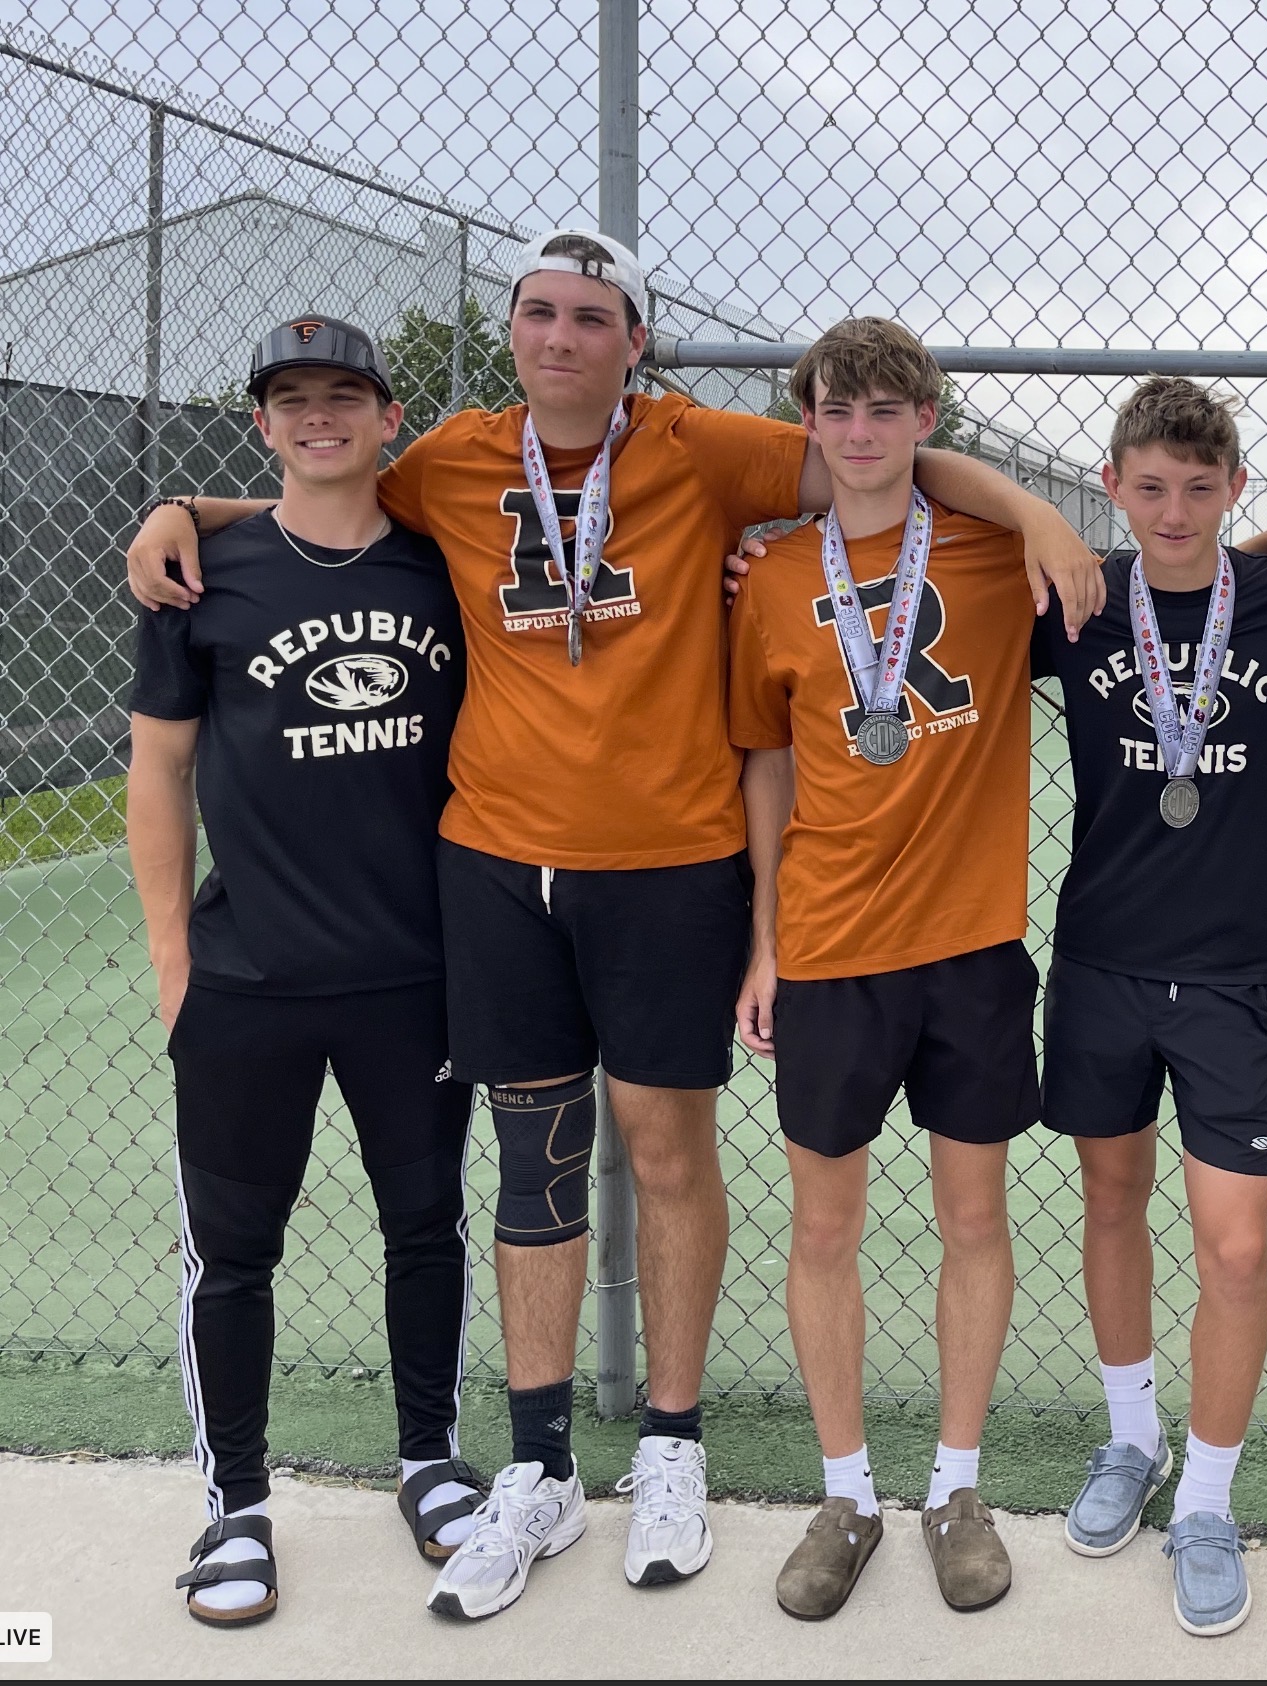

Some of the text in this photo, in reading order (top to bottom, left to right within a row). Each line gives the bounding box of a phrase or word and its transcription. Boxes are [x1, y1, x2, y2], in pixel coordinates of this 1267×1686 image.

[499, 488, 636, 617] R
[582, 601, 642, 622] TENNIS
[247, 610, 451, 689] REPUBLIC
[811, 574, 974, 741] R
[284, 714, 423, 759] TENNIS
[866, 722, 900, 756] COC
[926, 709, 980, 735] TENNIS
[1159, 710, 1179, 743] COC
